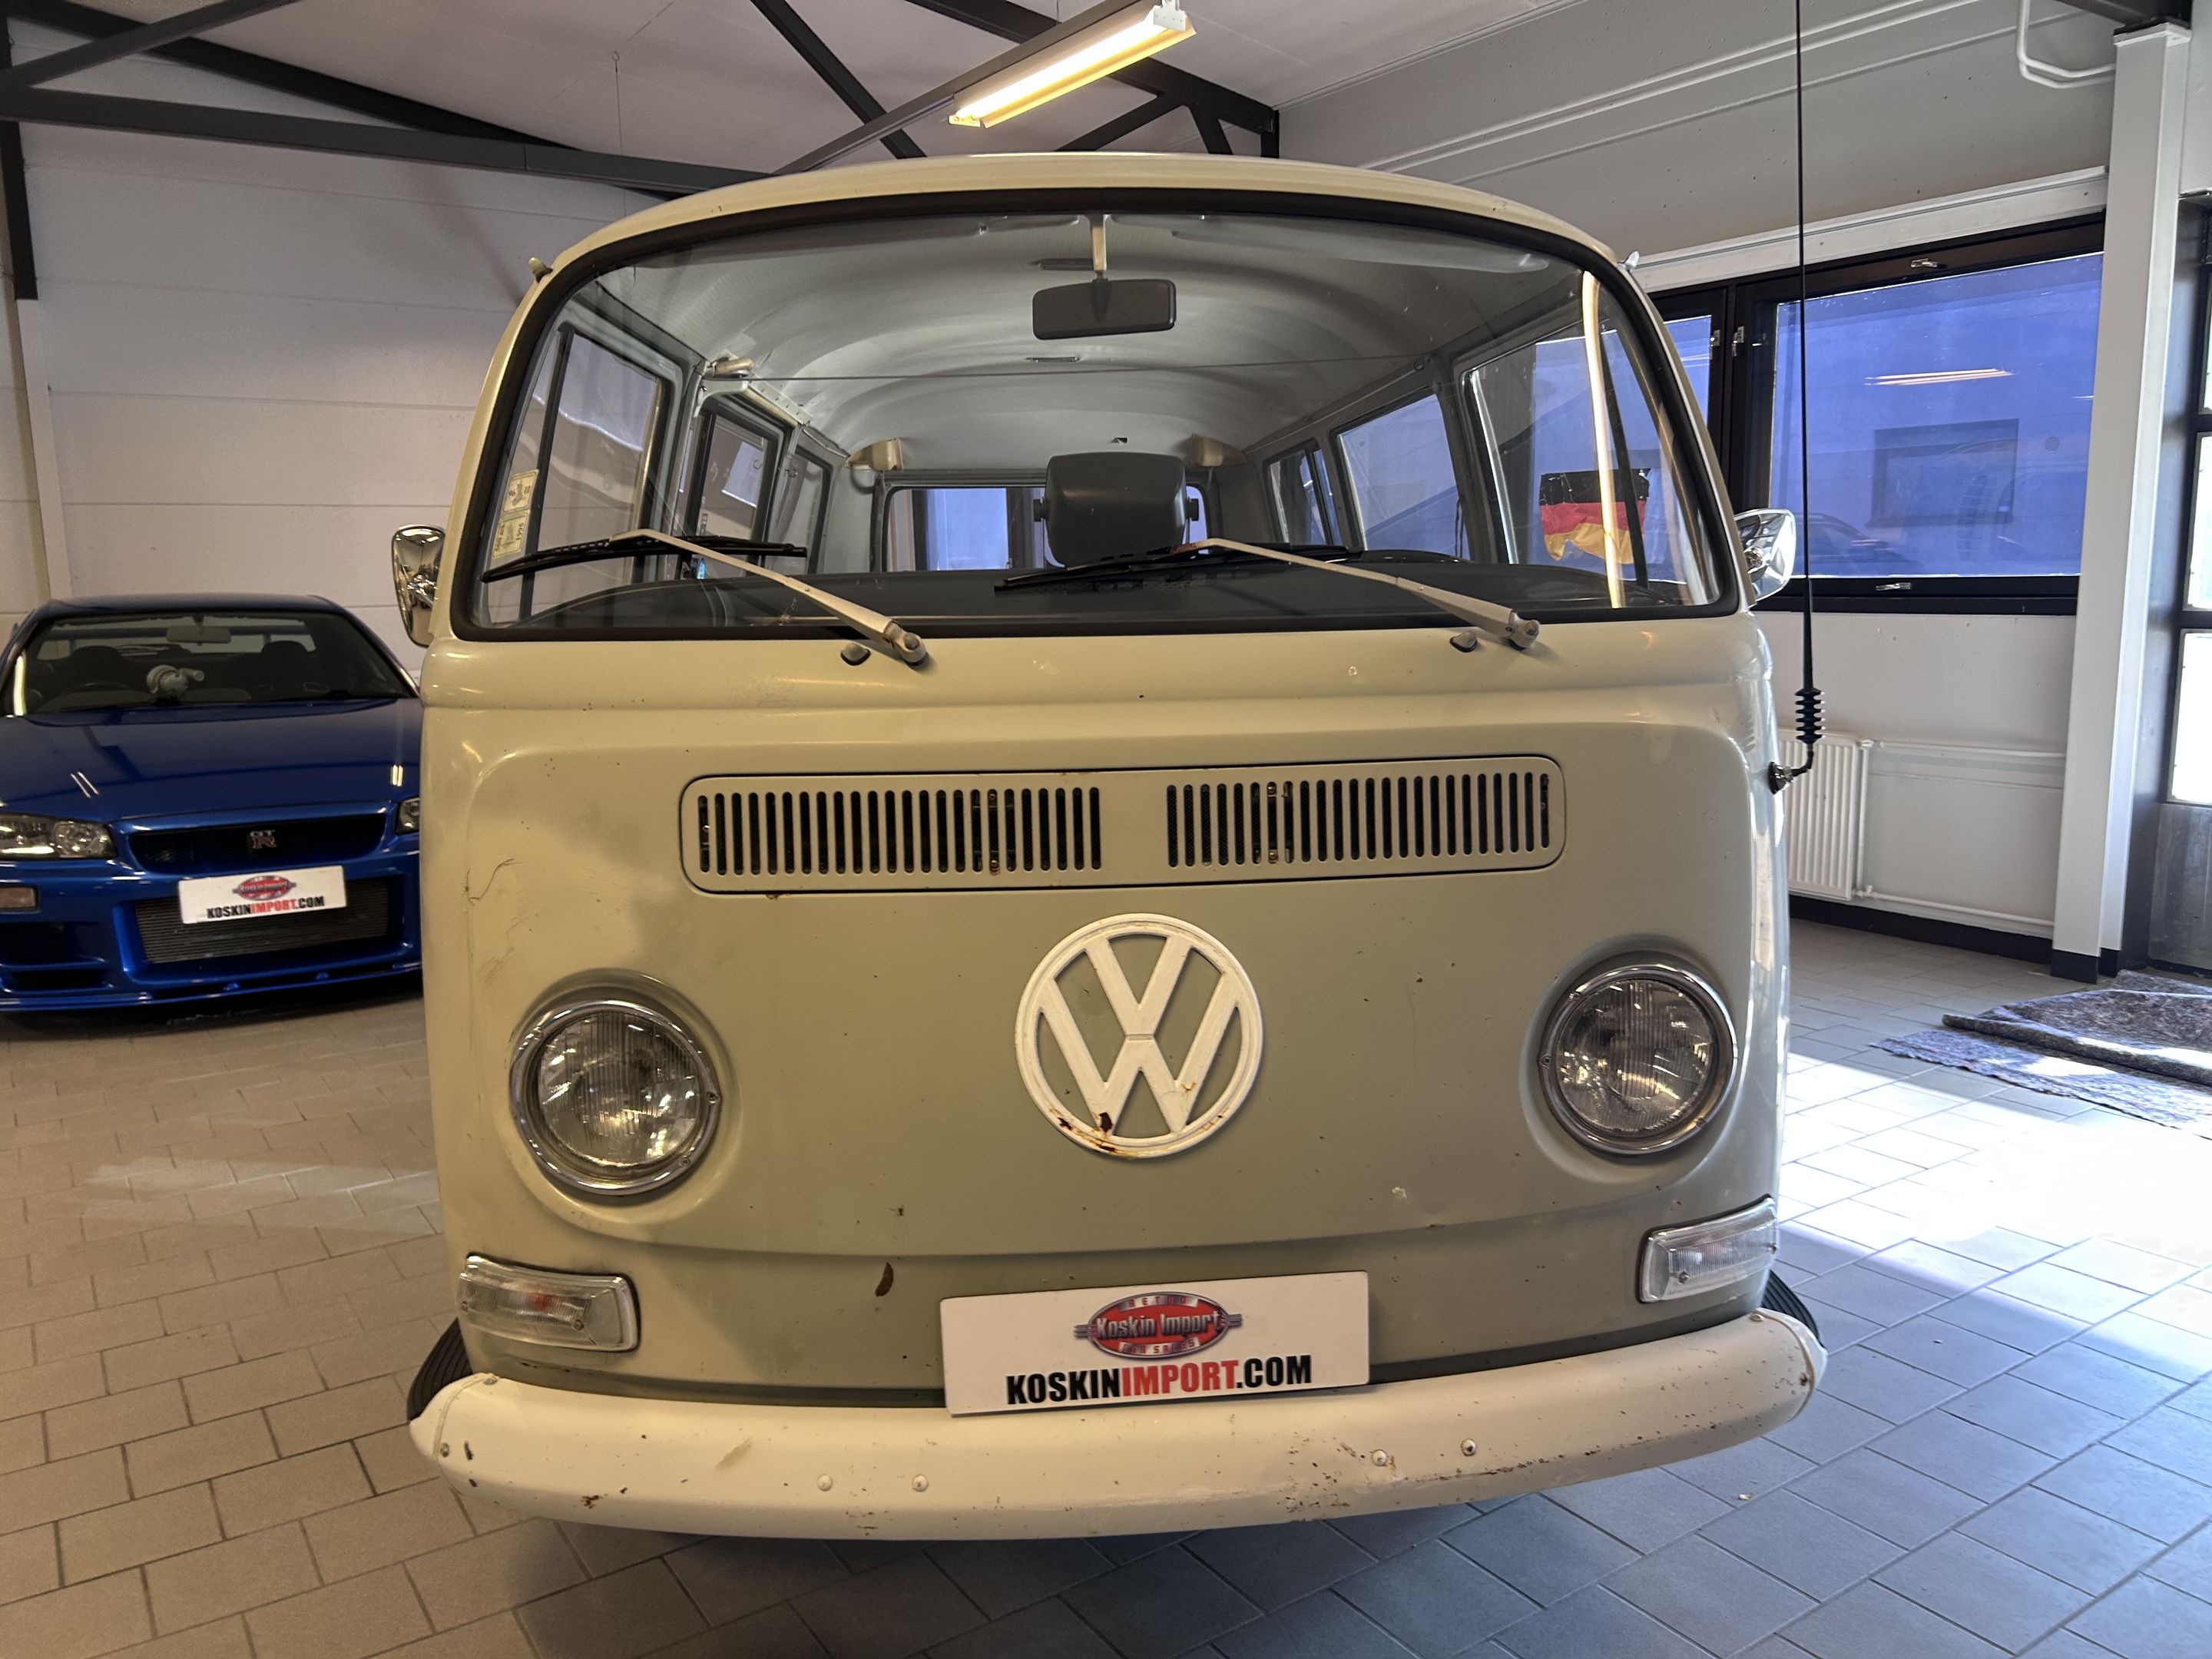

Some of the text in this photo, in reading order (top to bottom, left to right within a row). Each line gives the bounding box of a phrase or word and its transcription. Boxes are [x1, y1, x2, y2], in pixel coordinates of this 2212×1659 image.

[206, 896, 325, 919] KOSKINIMPORT.COM
[1025, 922, 1252, 1146] VW
[1128, 1294, 1187, 1308] RETRO
[1096, 1310, 1220, 1339] Koskin Import
[1006, 1354, 1312, 1405] KOSKINIMPORT.COM
